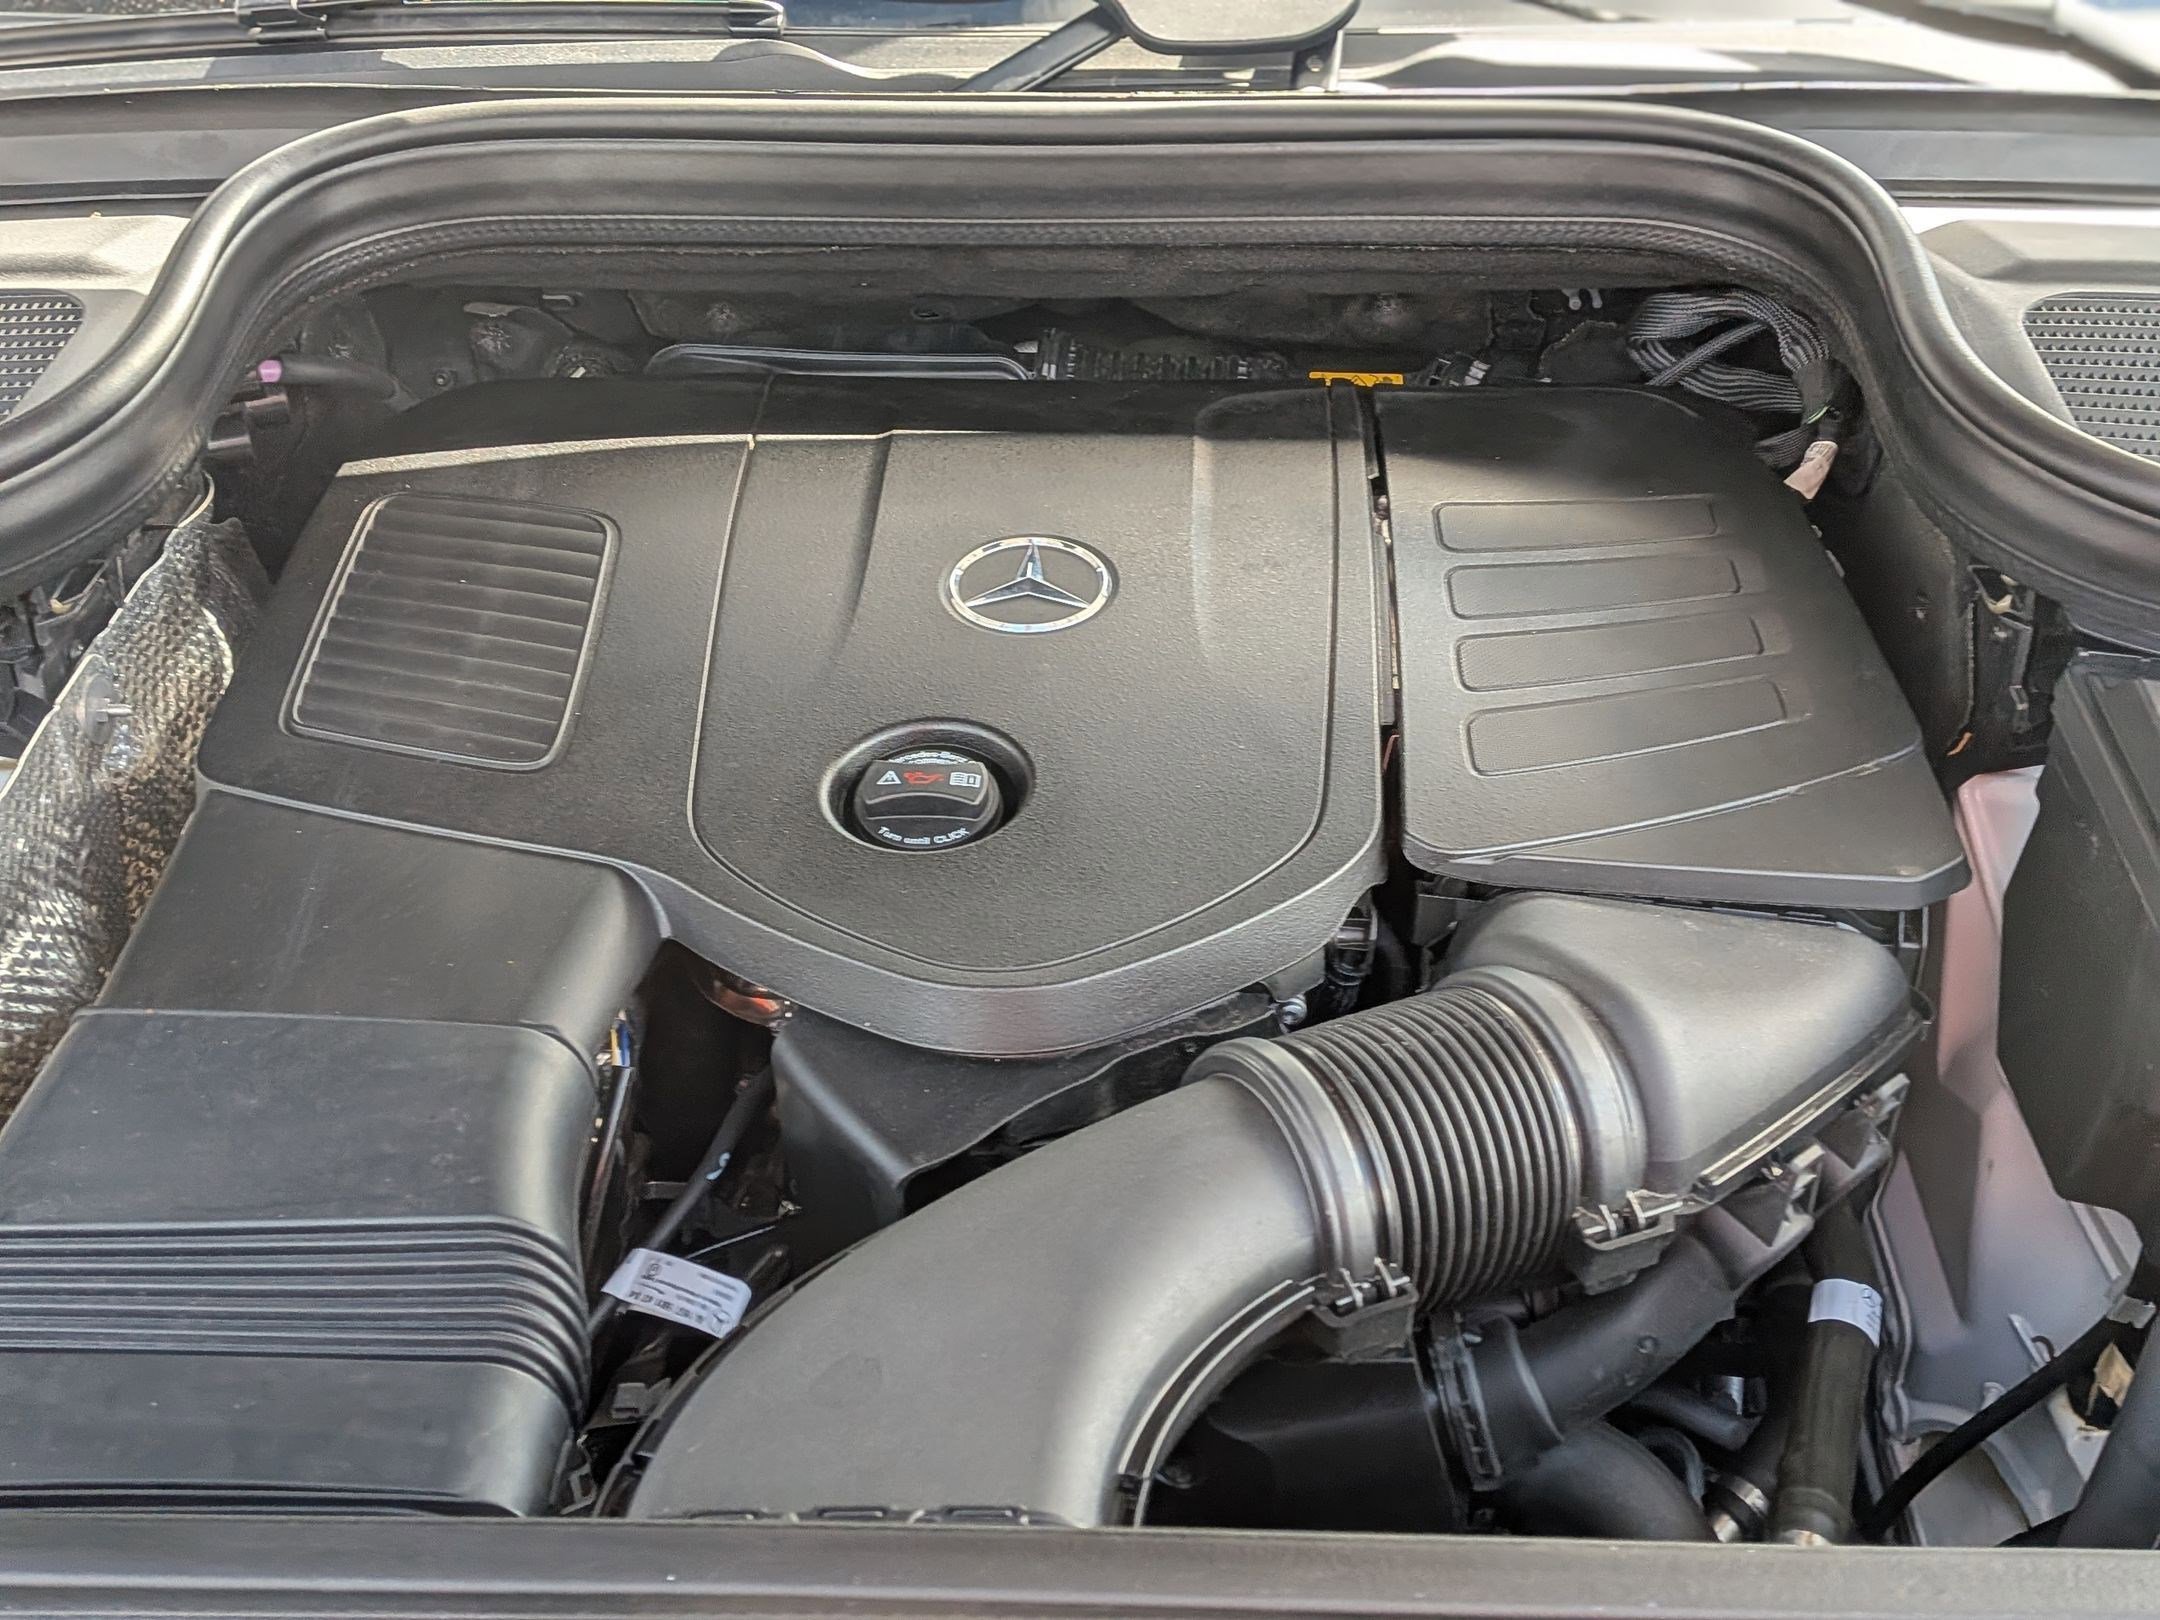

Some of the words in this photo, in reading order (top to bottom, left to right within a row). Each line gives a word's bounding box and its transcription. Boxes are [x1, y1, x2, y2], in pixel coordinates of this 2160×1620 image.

[878, 826, 902, 842] Turn
[903, 837, 931, 845] until
[933, 827, 970, 844] CLICK
